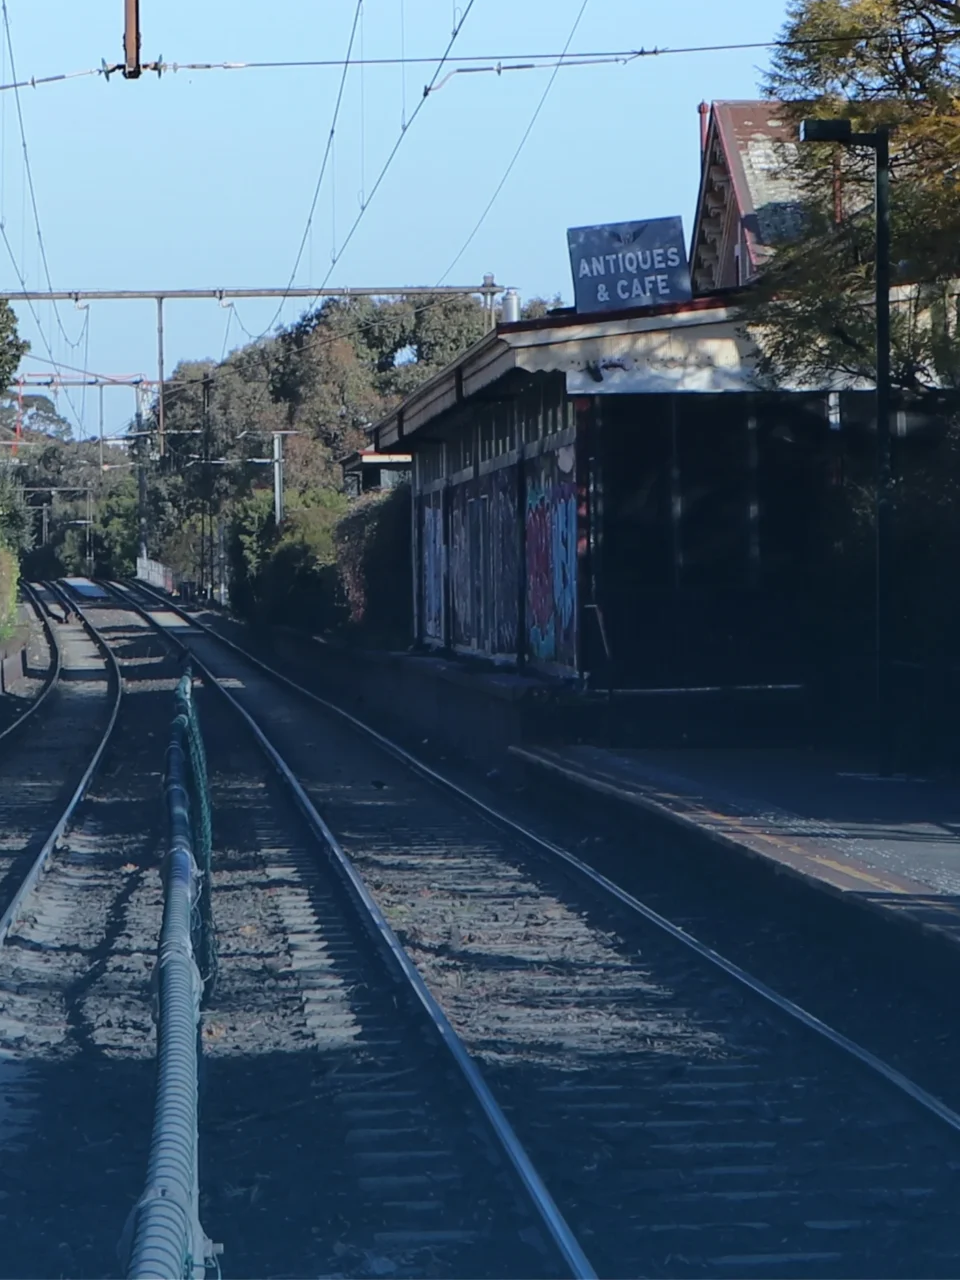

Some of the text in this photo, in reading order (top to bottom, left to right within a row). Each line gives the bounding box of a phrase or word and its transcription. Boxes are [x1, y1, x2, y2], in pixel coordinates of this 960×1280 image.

[579, 247, 680, 278] ANTIQUES
[597, 275, 670, 301] & CAFE
